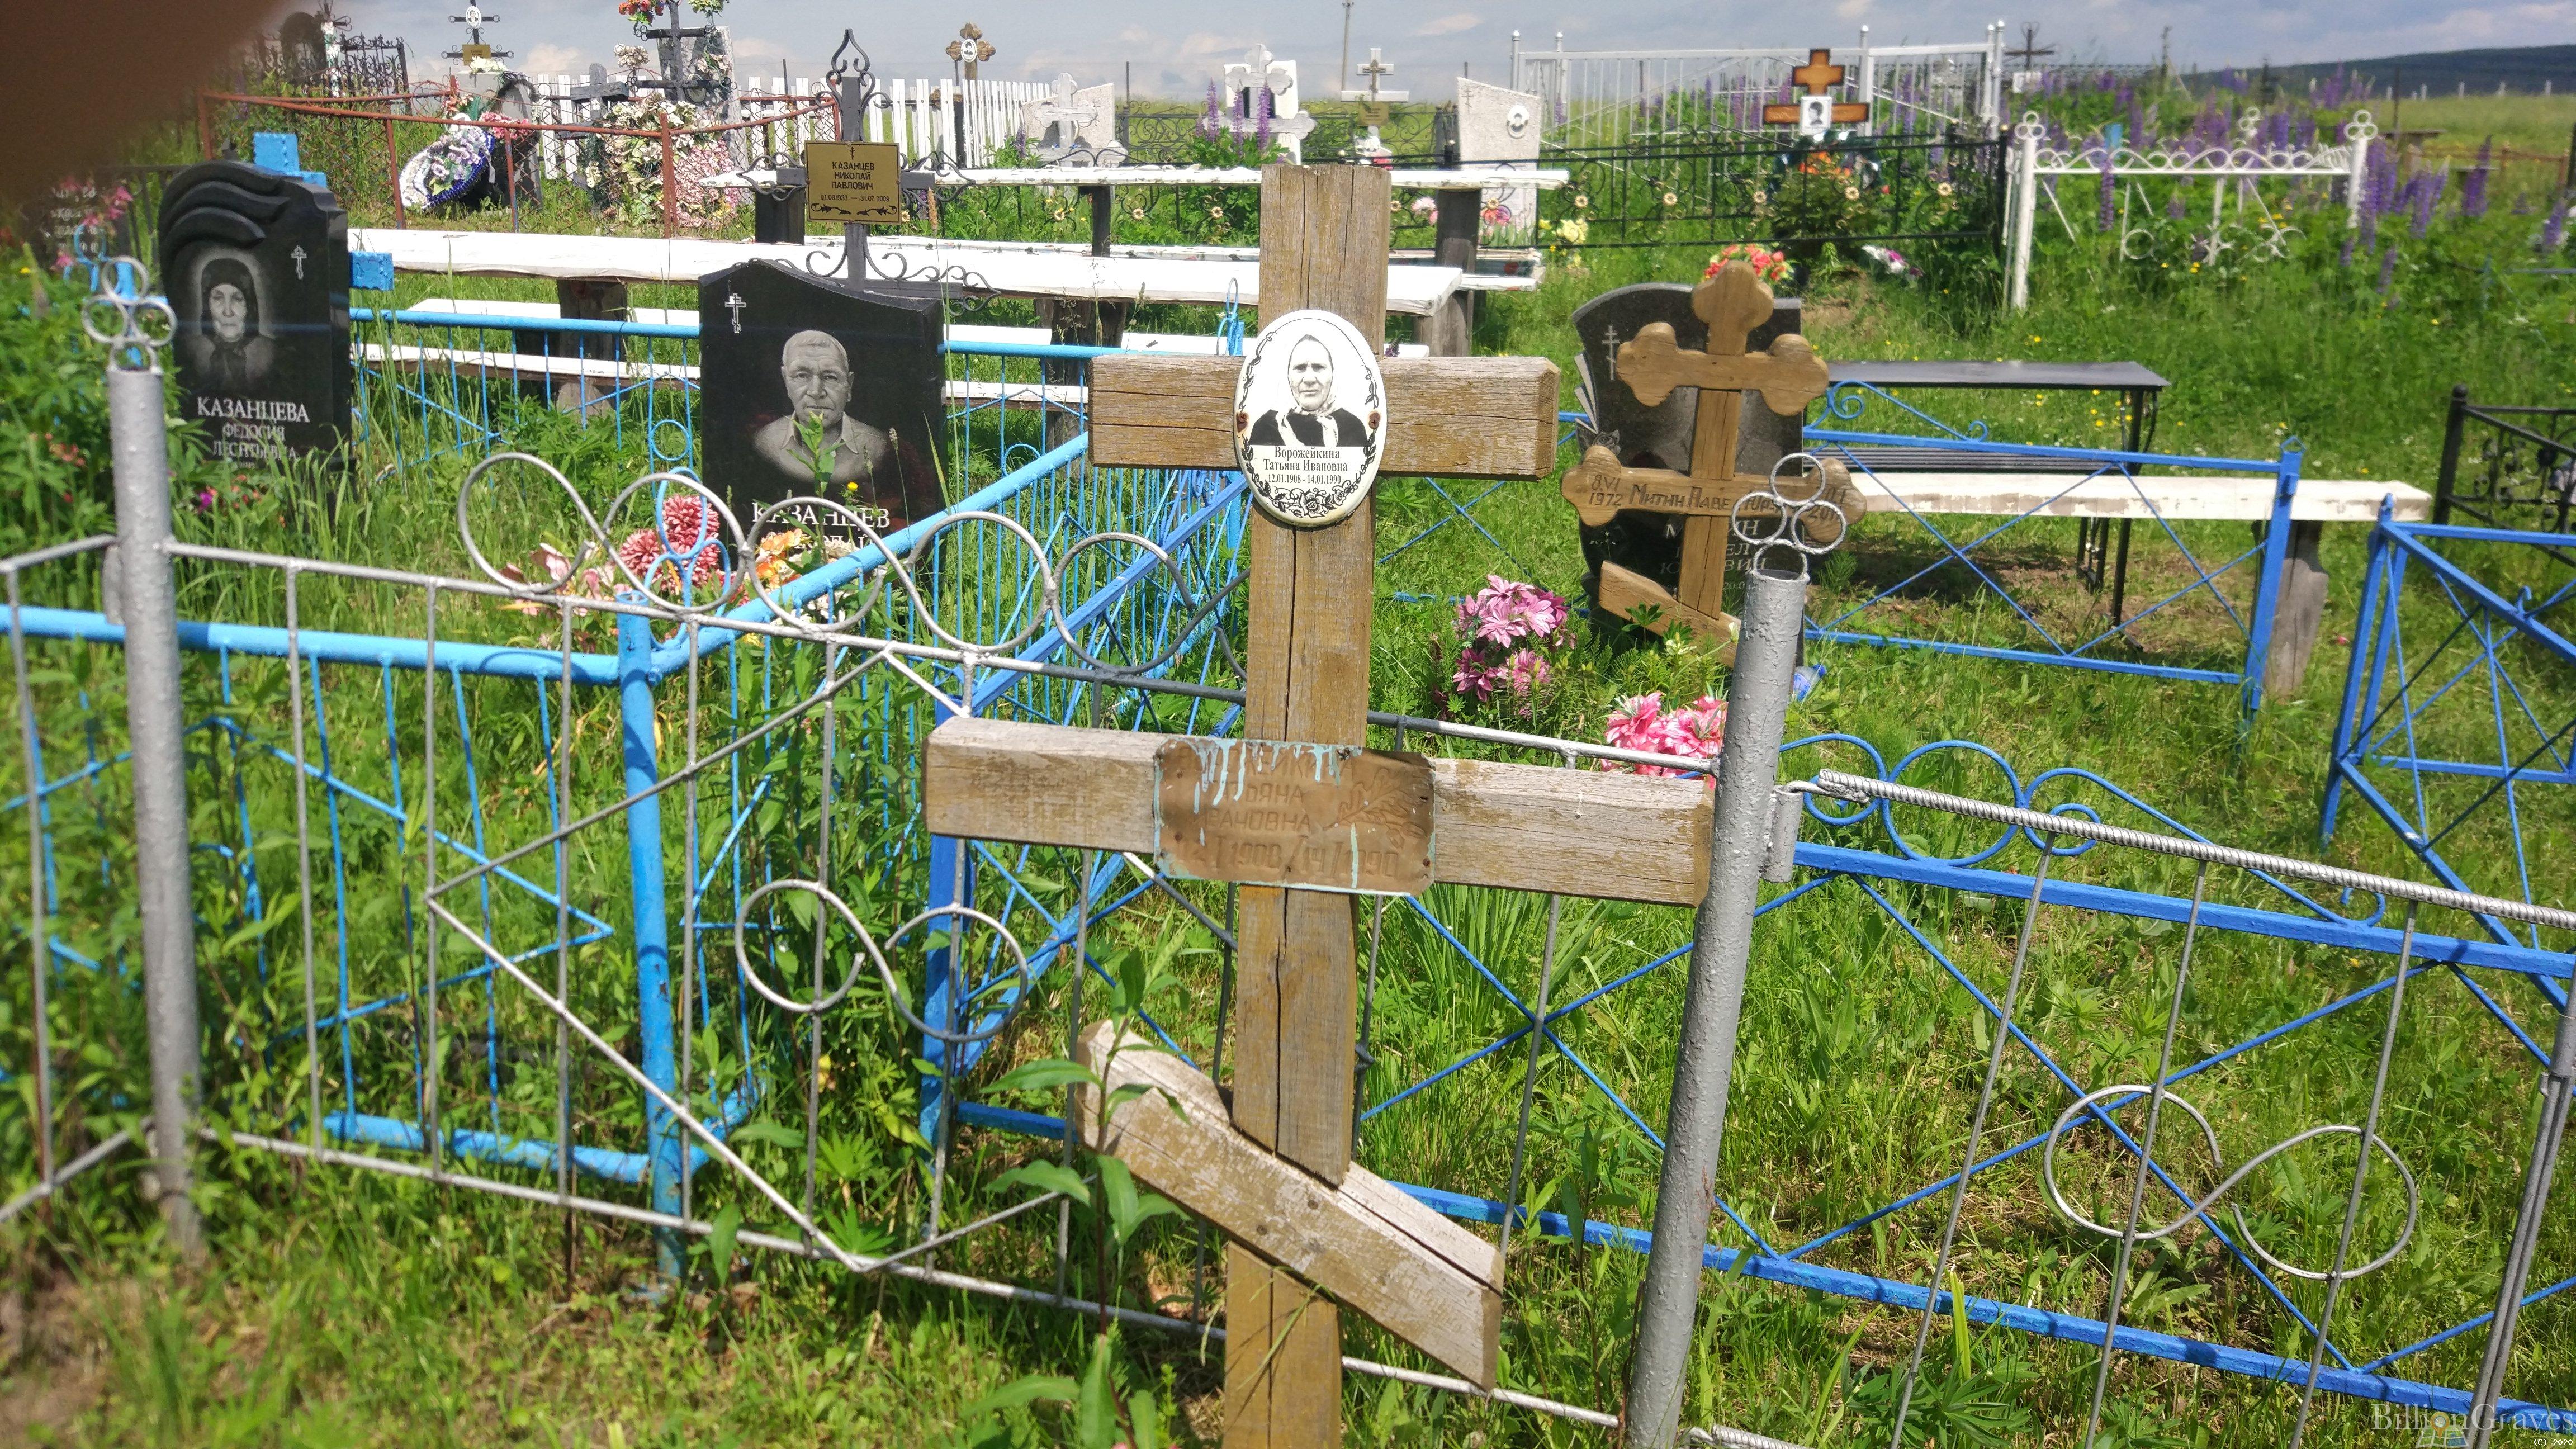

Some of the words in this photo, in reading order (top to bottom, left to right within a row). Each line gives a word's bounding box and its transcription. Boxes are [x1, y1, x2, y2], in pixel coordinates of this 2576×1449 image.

[832, 162, 875, 171] КАЗАНЦЕВ
[834, 172, 871, 180] НИКОЛАЙ
[831, 181, 873, 190] ПАВЛОВИЧ
[197, 396, 310, 423] КАЗАНЦЕВА
[1275, 446, 1340, 461] Ворожейкина
[1263, 458, 1300, 471] Татьяна
[1303, 459, 1348, 471] Ивановна
[1268, 473, 1301, 484] 12.01.1908
[1307, 474, 1342, 484] 14.01.1990
[1589, 493, 1622, 506] 1972
